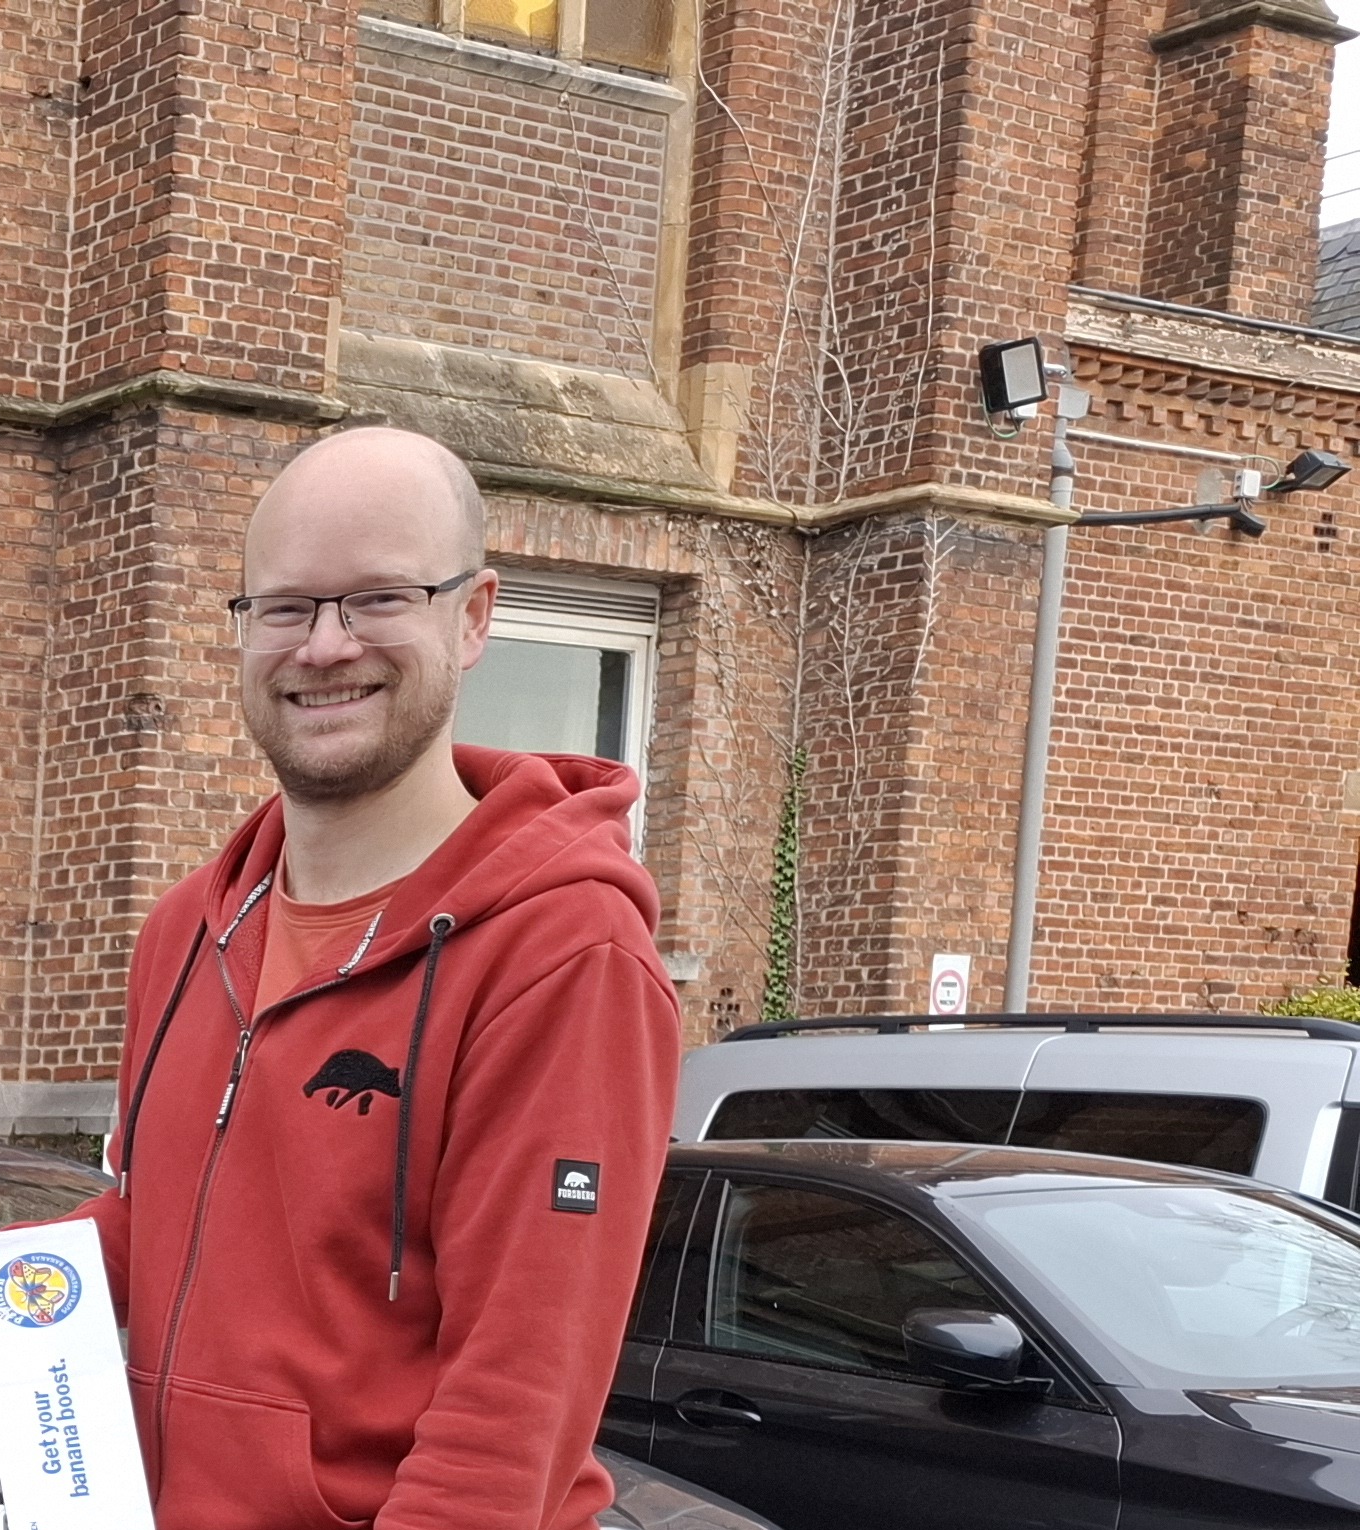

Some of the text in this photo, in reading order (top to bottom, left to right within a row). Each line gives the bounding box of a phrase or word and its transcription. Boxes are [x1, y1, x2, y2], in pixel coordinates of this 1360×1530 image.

[35, 1391, 61, 1474] Get your
[48, 1358, 90, 1498] banana boost.
